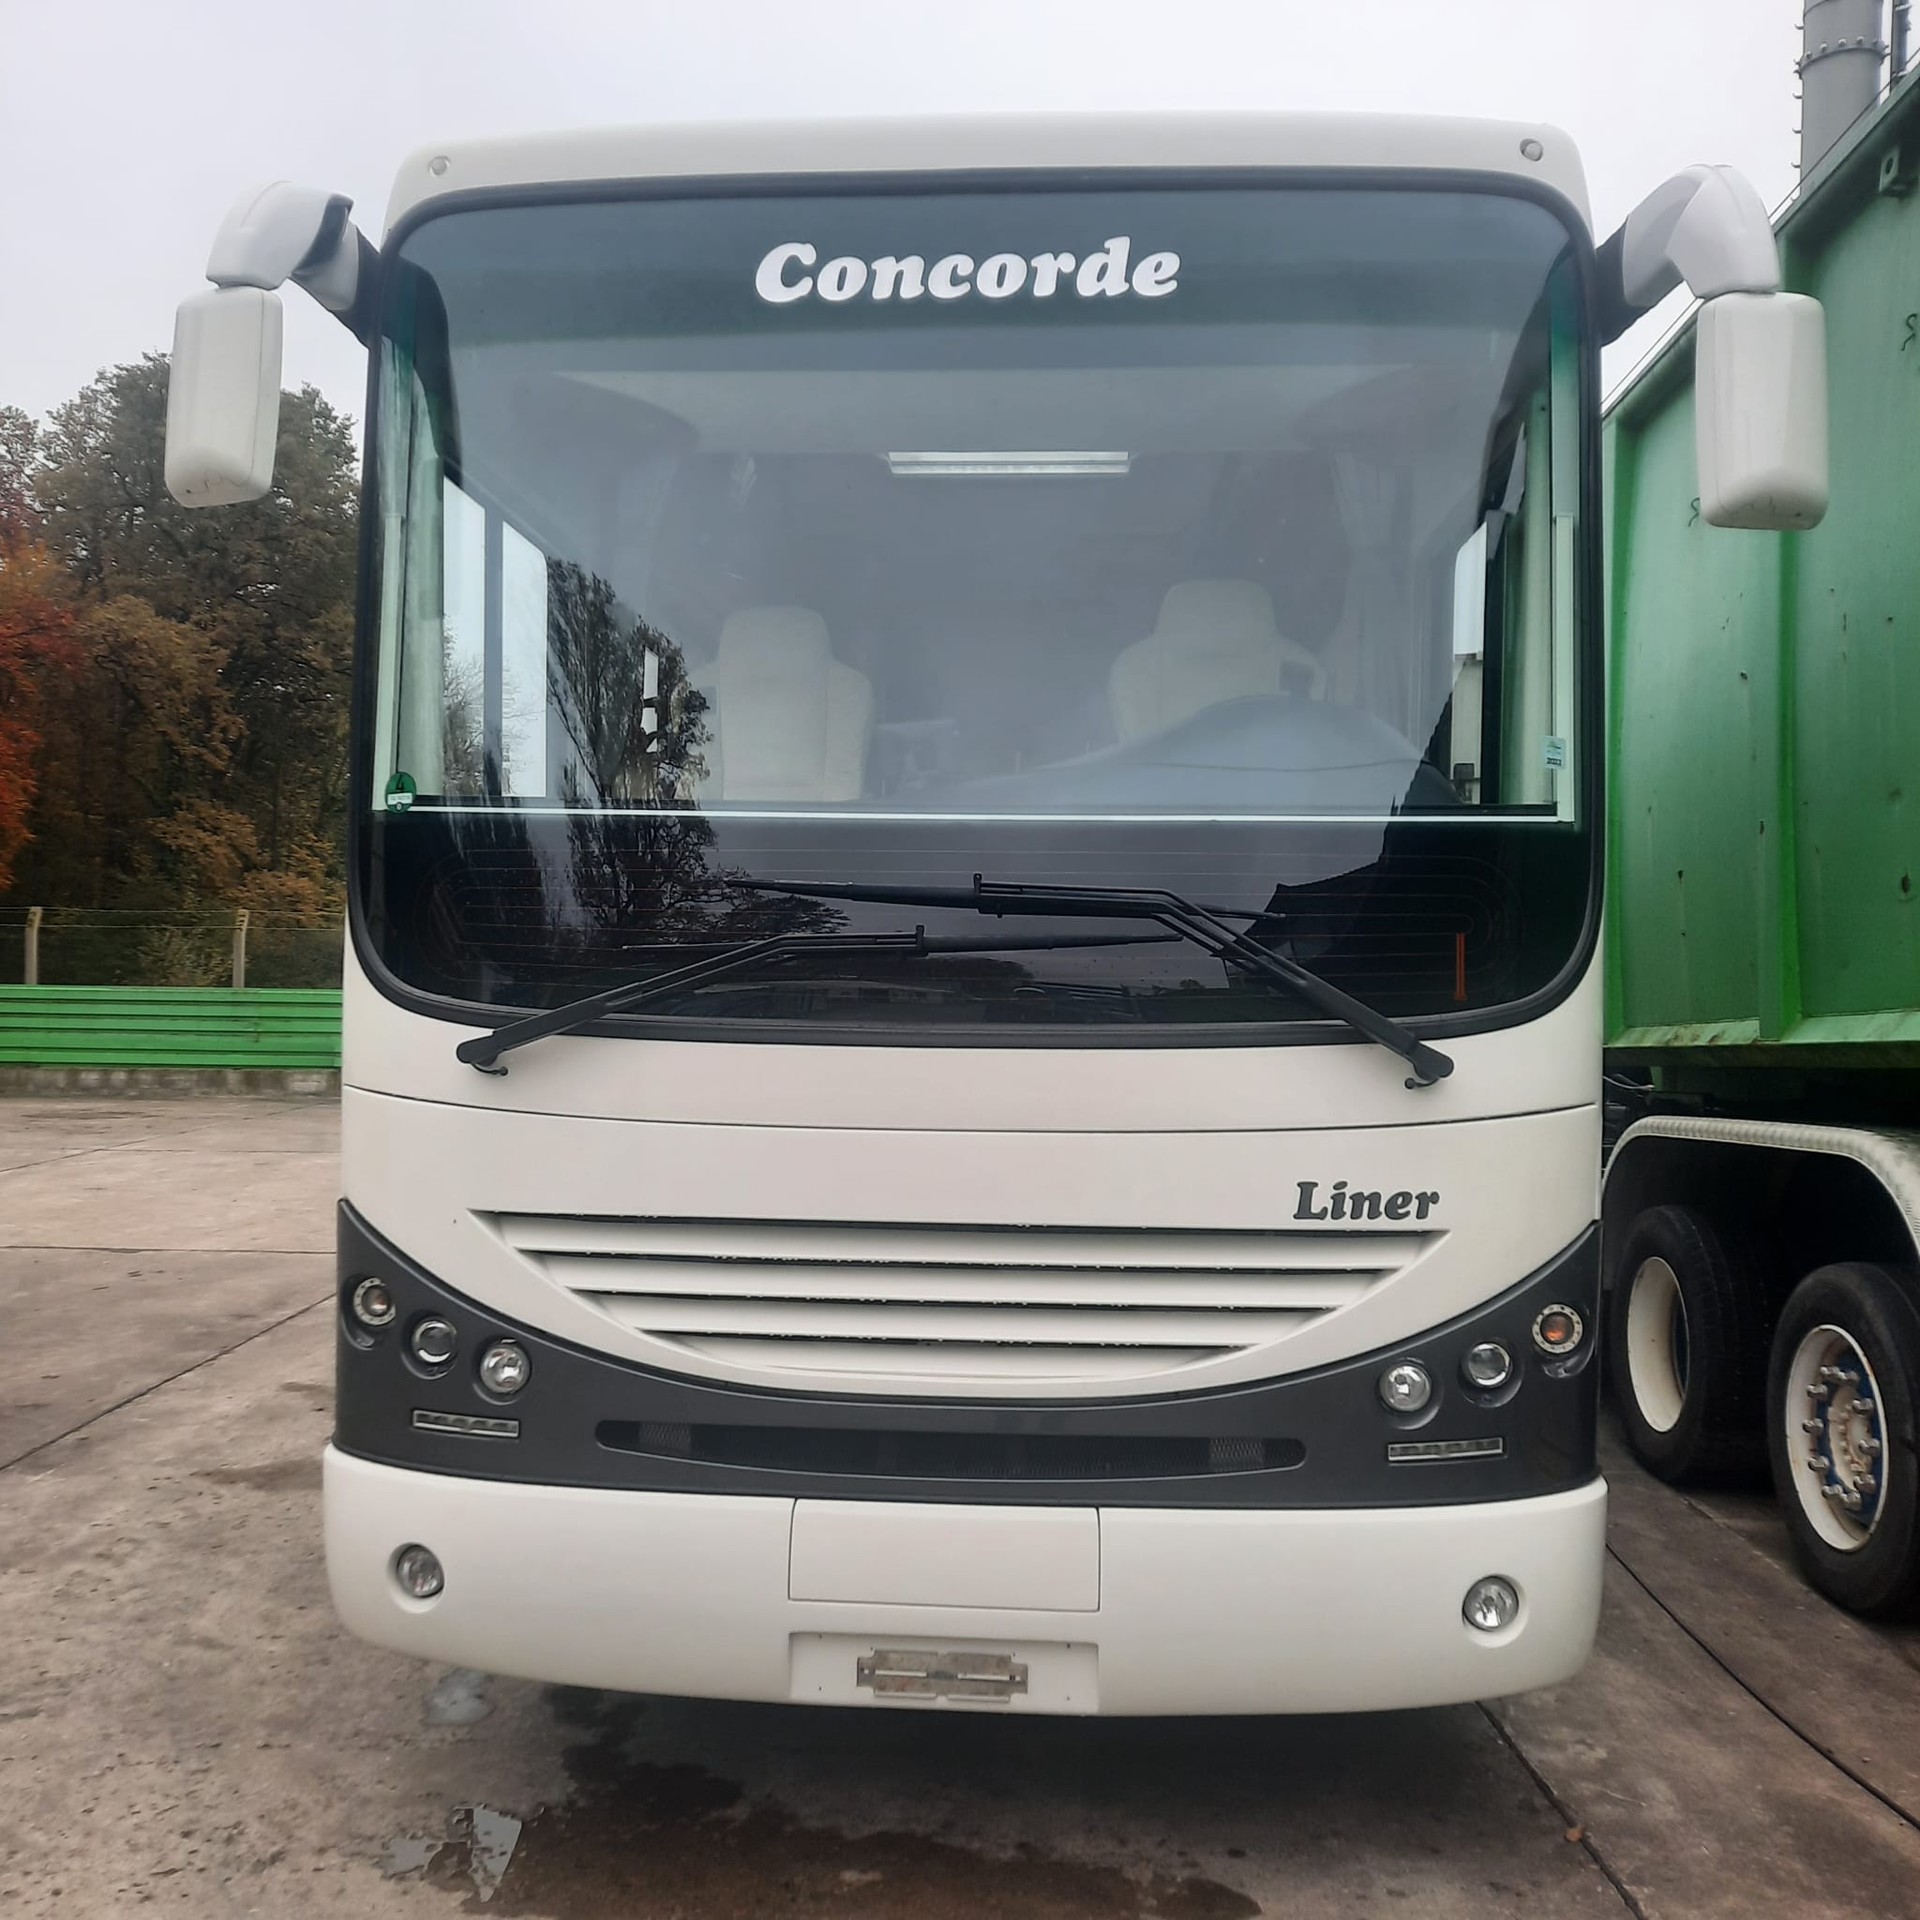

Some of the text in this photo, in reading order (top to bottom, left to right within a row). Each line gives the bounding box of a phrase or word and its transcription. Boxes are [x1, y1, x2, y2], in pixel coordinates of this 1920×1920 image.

[755, 236, 1181, 303] Concorde
[395, 773, 405, 793] 4
[1293, 1181, 1440, 1220] Liner
